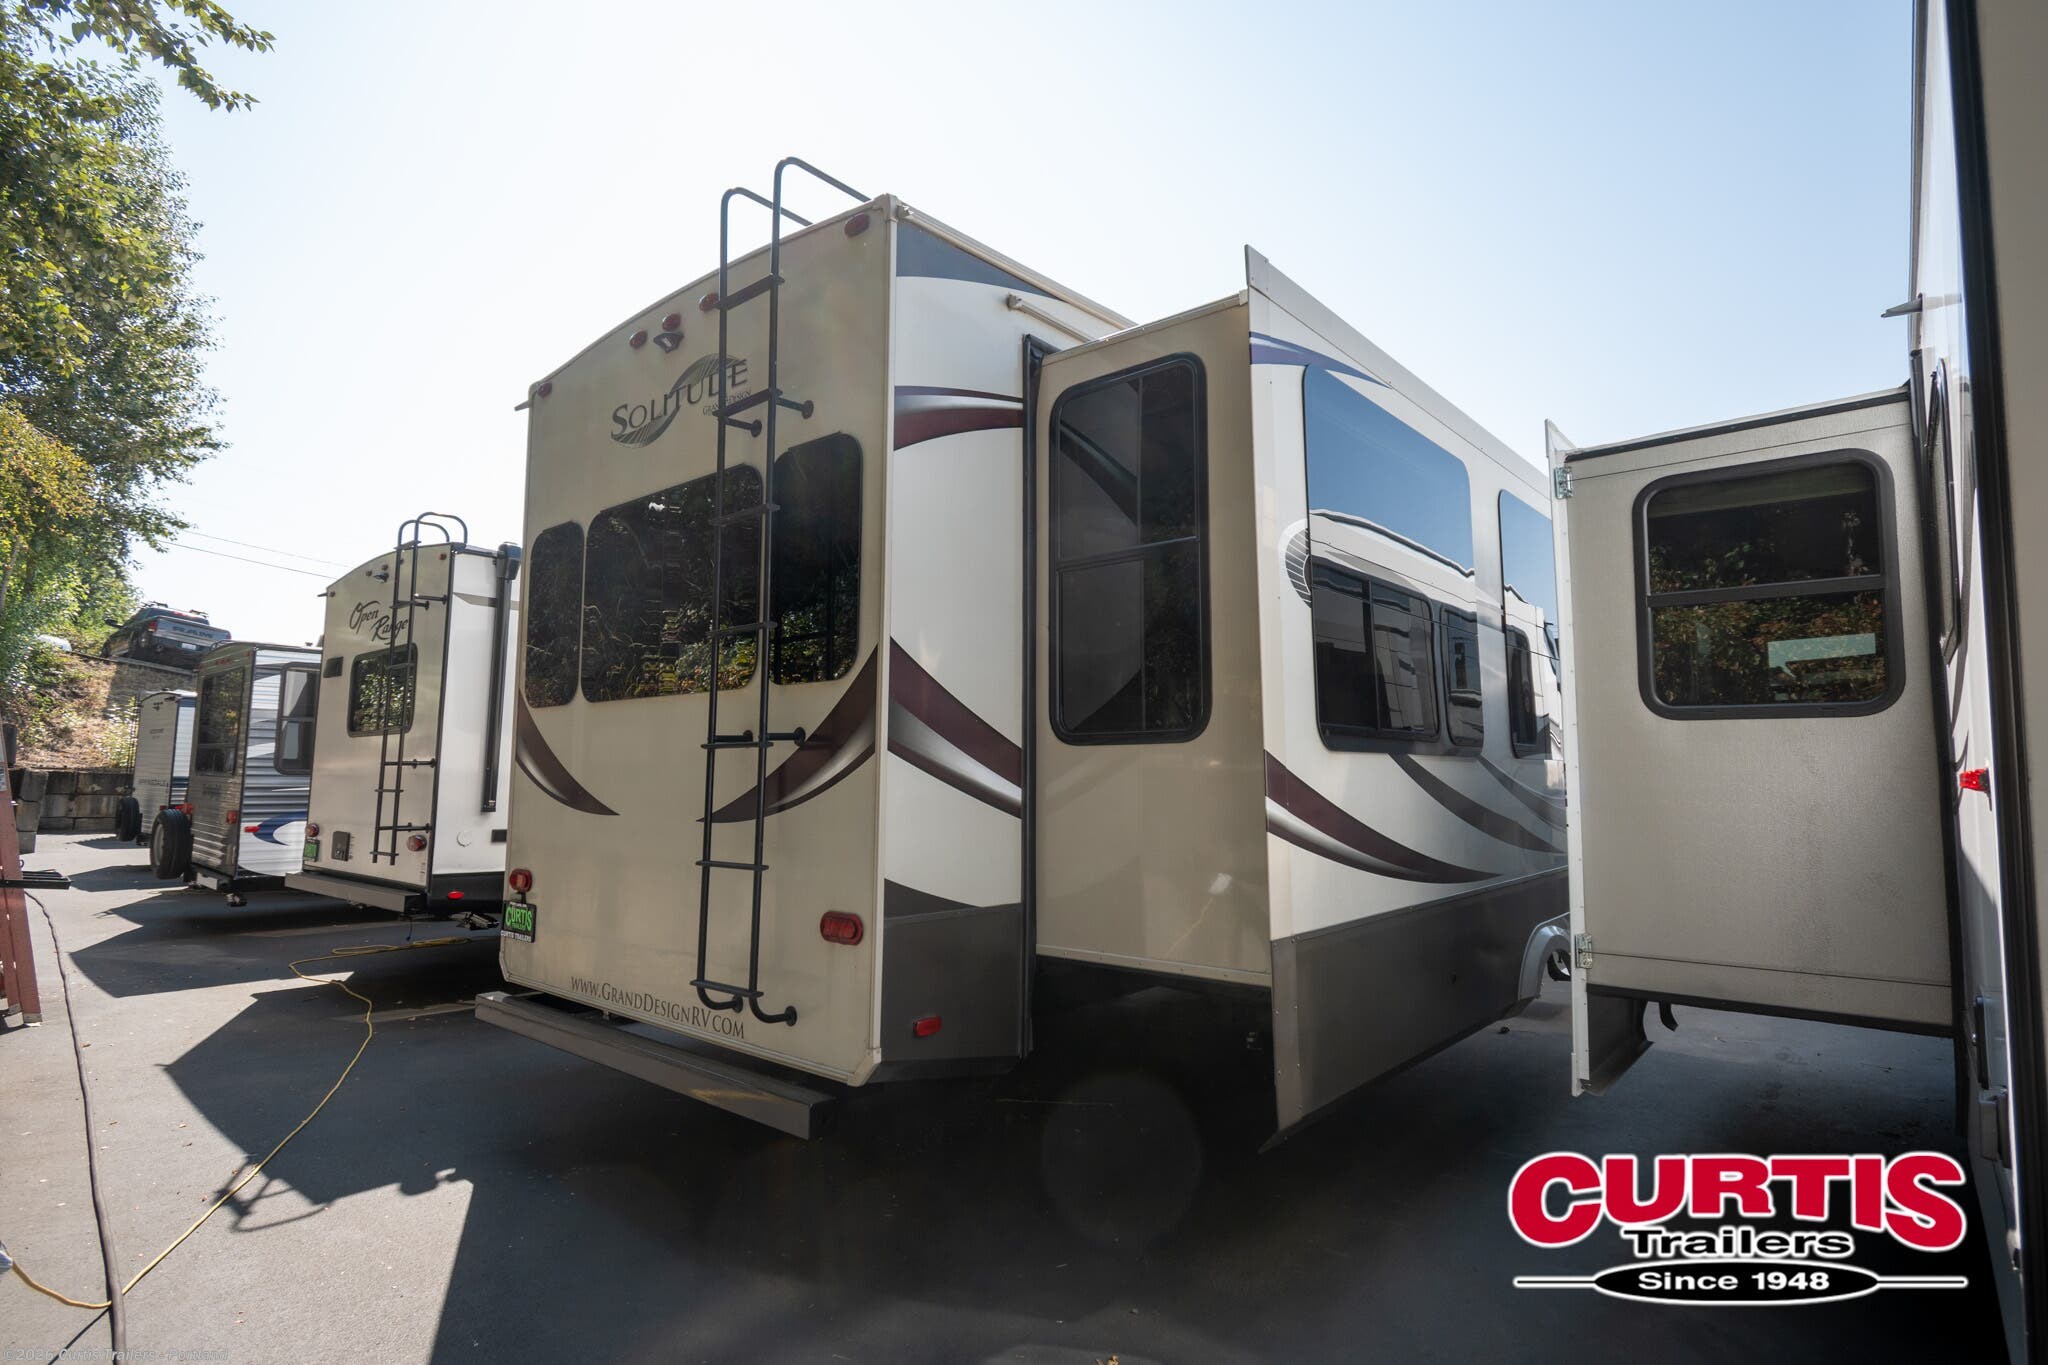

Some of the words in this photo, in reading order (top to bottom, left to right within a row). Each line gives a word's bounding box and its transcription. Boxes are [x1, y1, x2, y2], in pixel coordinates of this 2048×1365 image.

[611, 358, 748, 440] SOLITUDE
[349, 600, 381, 634] Open
[369, 615, 408, 645] Rage
[172, 625, 212, 640] RAM
[505, 906, 532, 931] CURTIS
